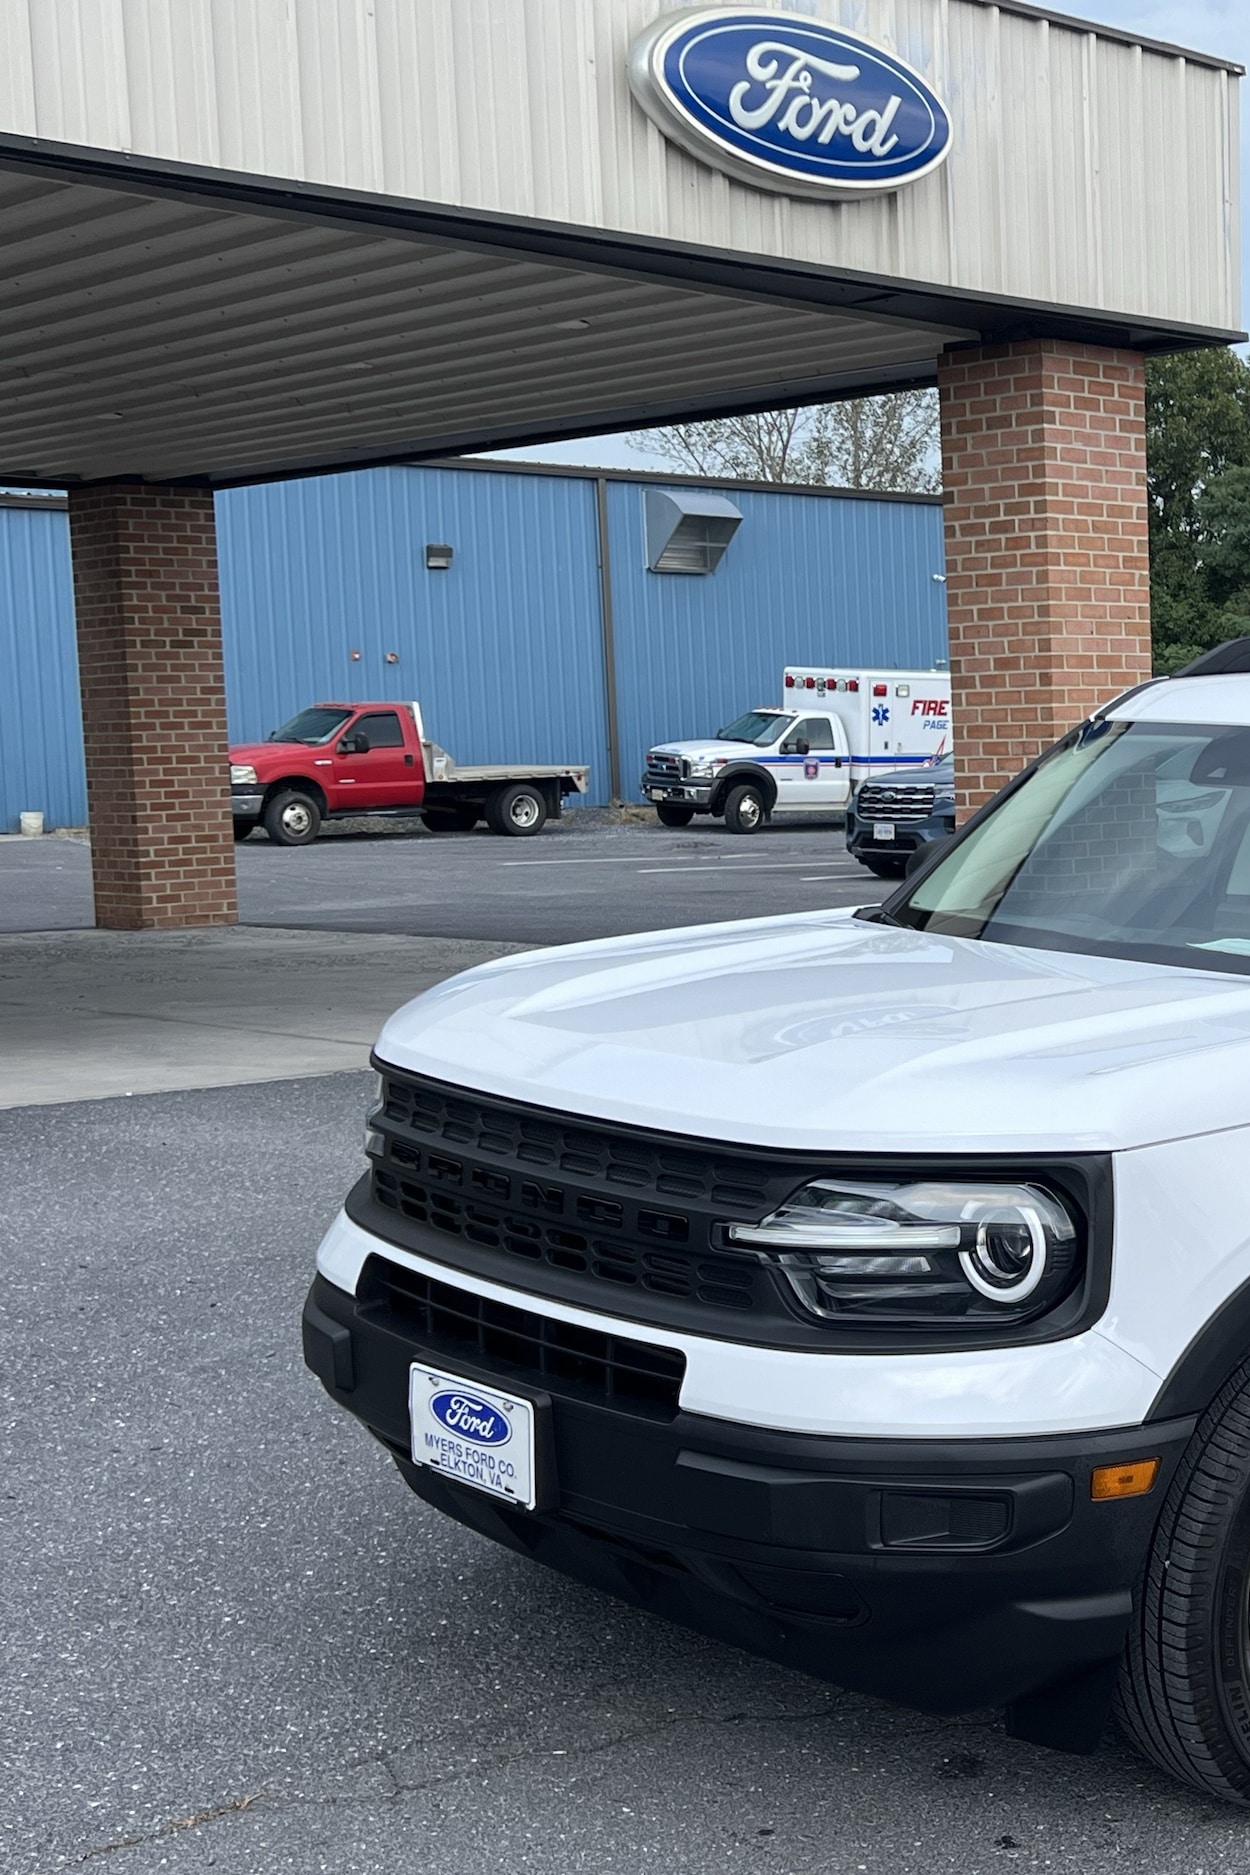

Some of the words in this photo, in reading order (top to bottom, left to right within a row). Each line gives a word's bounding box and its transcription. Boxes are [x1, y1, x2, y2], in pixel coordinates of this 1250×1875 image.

[729, 41, 902, 157] Ford
[911, 699, 950, 716] FIRE
[923, 720, 949, 730] PAGE
[390, 1139, 689, 1243] BRONCO
[445, 1396, 495, 1439] Ford
[424, 1432, 463, 1458] MYERS
[466, 1447, 496, 1470] FORD
[498, 1460, 518, 1480] CO.
[440, 1453, 487, 1483] ELKTON,
[488, 1472, 503, 1489] VA
[1224, 1586, 1237, 1668] DEFENDER
